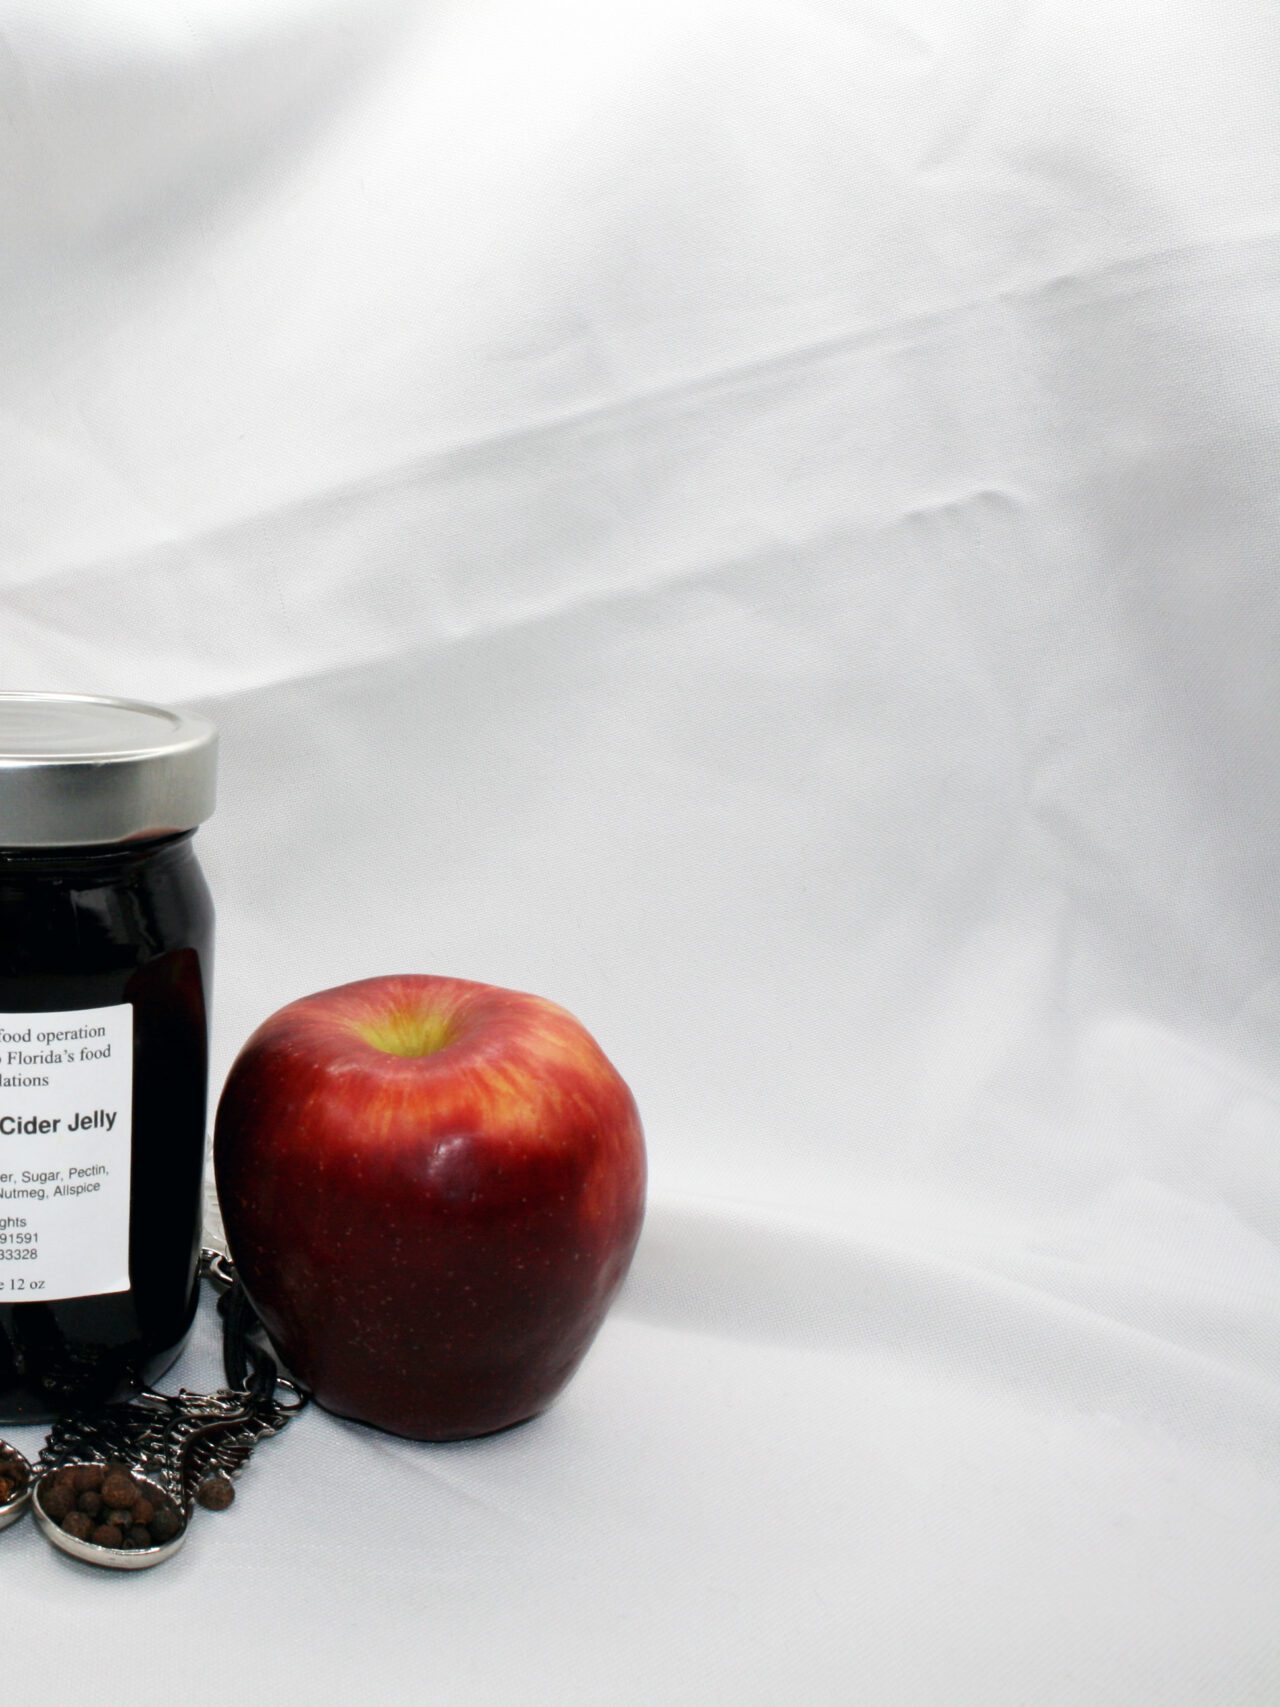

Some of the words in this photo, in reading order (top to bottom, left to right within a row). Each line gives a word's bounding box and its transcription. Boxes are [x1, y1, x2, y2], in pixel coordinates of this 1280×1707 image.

[36, 1025, 106, 1045] operation
[7, 1049, 75, 1065] Florida's
[80, 1043, 111, 1062] food
[67, 1109, 118, 1132] Jelly
[21, 1171, 64, 1185] Sugar,
[68, 1163, 109, 1180] Pectin,
[53, 1181, 101, 1197] Allspice
[10, 1278, 25, 1290] 12
[29, 1280, 45, 1290] oz
